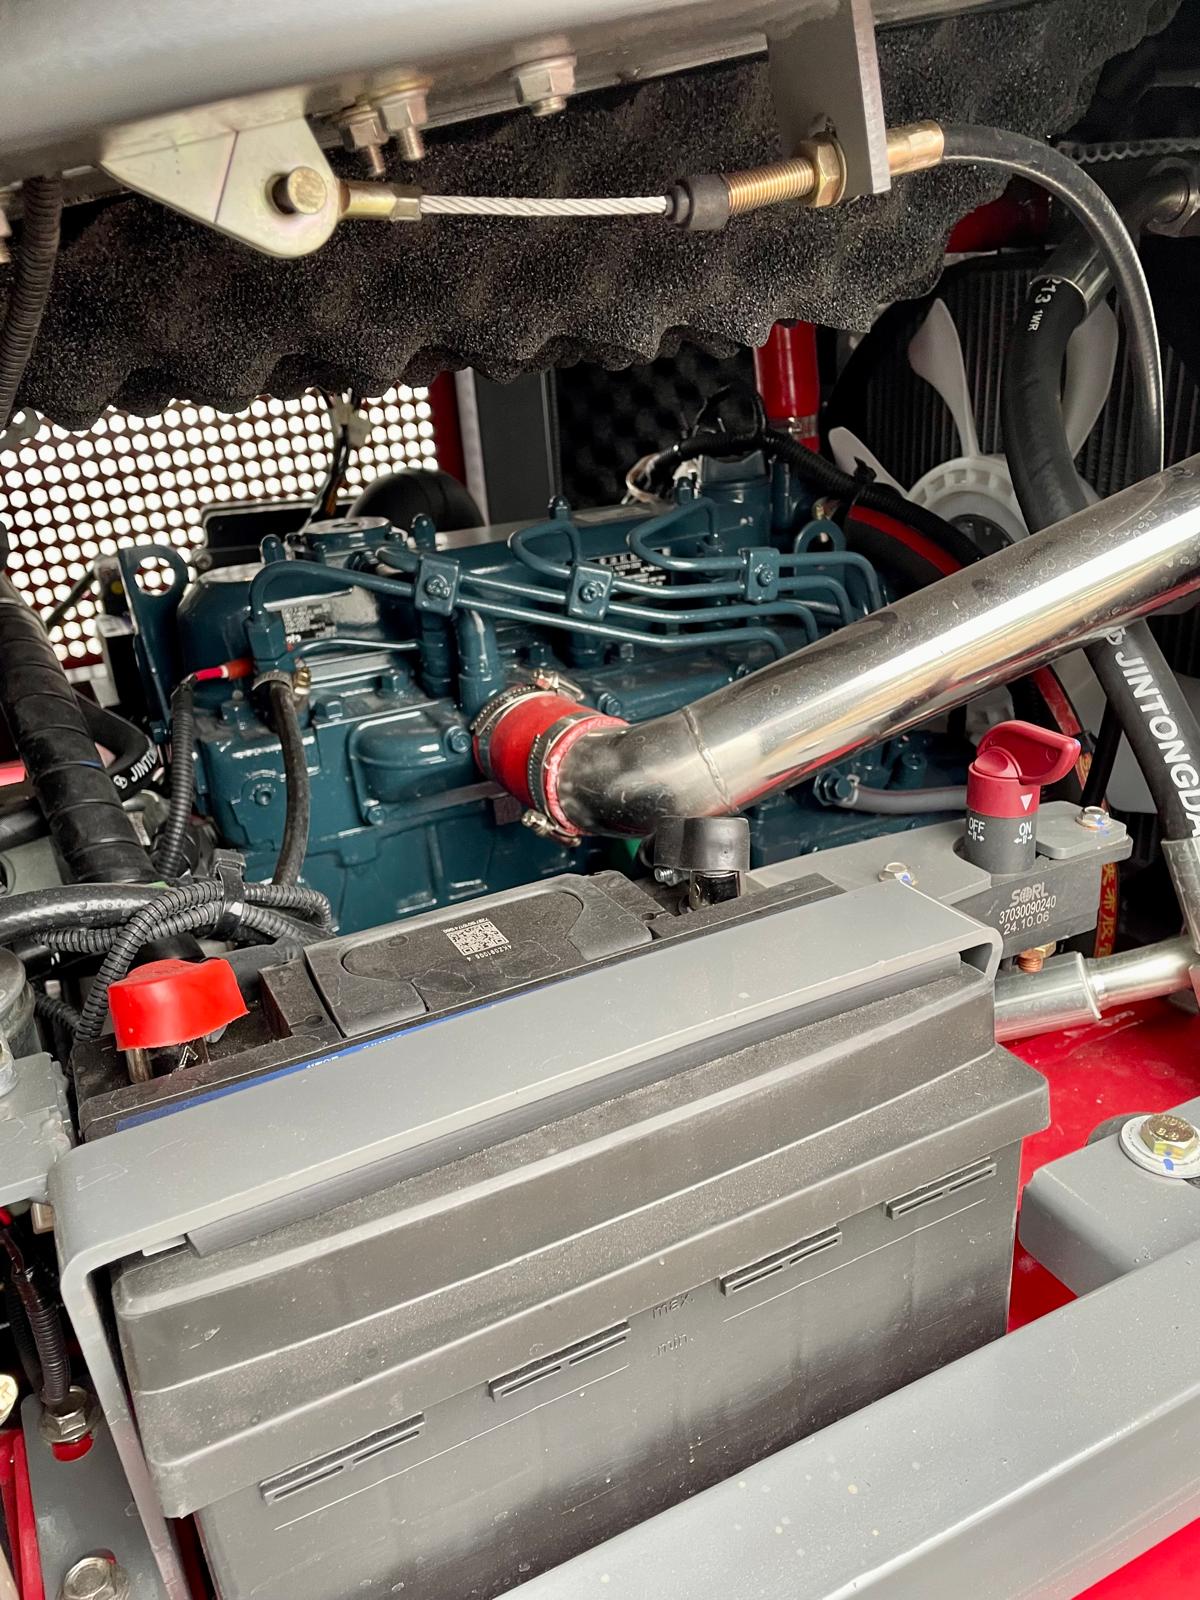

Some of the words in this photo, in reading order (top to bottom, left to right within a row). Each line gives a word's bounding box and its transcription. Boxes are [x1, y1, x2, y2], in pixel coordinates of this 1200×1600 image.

[968, 817, 986, 834] OFF
[1018, 821, 1032, 836] ON
[1009, 881, 1048, 908] SORL
[999, 895, 1057, 924] 37030090240
[1003, 911, 1050, 936] 24.10.06
